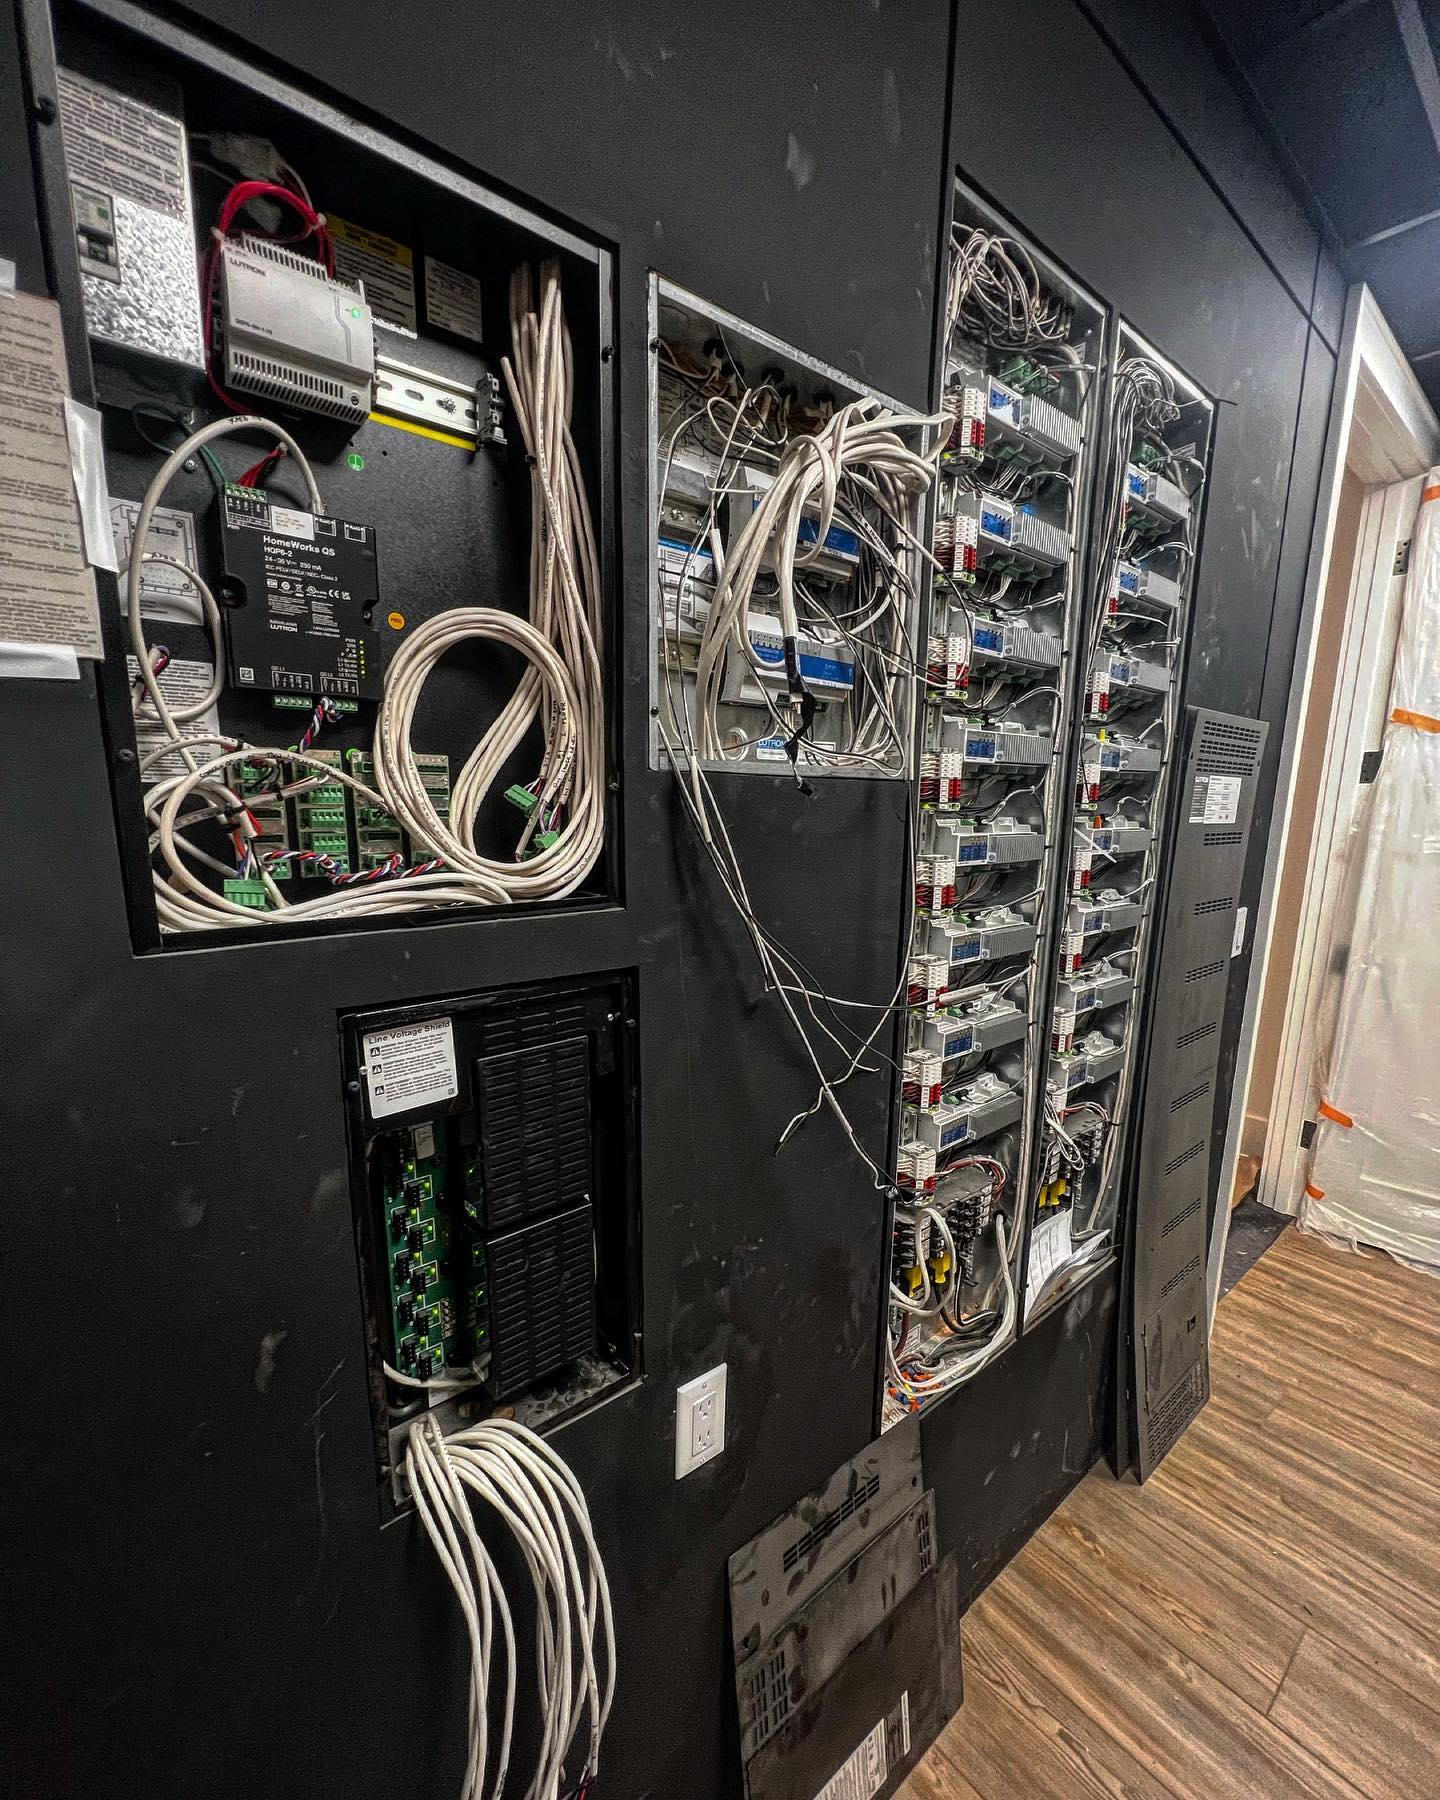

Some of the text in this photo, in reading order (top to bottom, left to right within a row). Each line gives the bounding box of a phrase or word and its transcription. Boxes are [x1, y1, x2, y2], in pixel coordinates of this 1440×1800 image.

[229, 257, 266, 277] LUTRON
[263, 535, 336, 557] HomeWorks QS
[263, 545, 293, 558] HQP6-2
[299, 561, 312, 570] 250
[312, 563, 323, 572] mA
[269, 623, 298, 633] LUTRON
[368, 1021, 450, 1044] Line Voltage Shield
